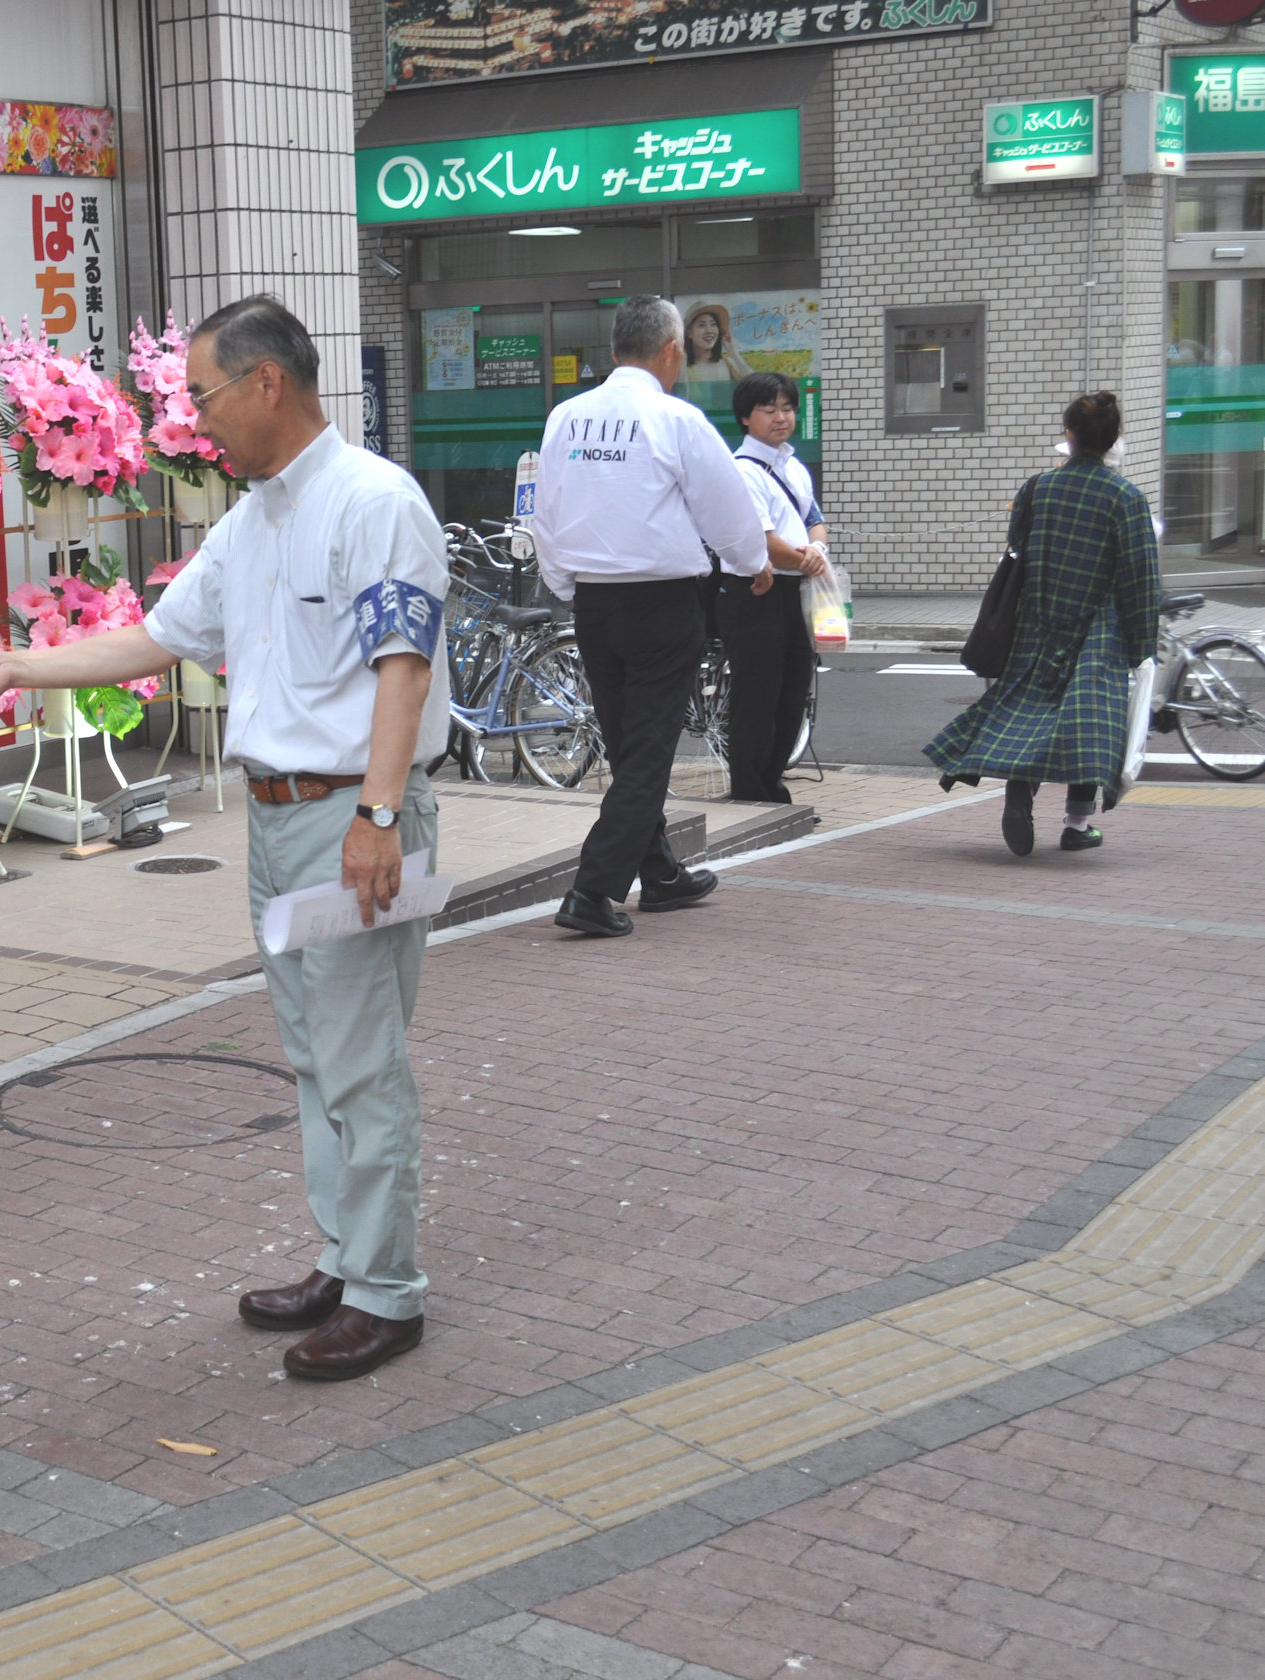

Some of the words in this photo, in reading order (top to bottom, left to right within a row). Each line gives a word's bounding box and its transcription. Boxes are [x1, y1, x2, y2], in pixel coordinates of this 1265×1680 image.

[634, 1, 872, 51] この街が好きです。
[879, 0, 976, 30] ふくしん
[1023, 106, 1089, 132] ふくしん
[632, 127, 733, 160] キャッシュ
[991, 140, 1087, 157] キャッシュサービスコーナー
[434, 146, 580, 201] ふくしん
[601, 158, 766, 198] サービスコーナー
[80, 196, 104, 372] 選べる楽しさ
[735, 303, 803, 327] ボーナスは、
[752, 319, 816, 340] しんきんへ
[481, 348, 537, 358] サービスコーナー
[491, 338, 526, 347] キャッシュ
[483, 360, 534, 371] ATMご利用時間
[568, 418, 640, 443] STAFF
[582, 448, 626, 462] NOSAI
